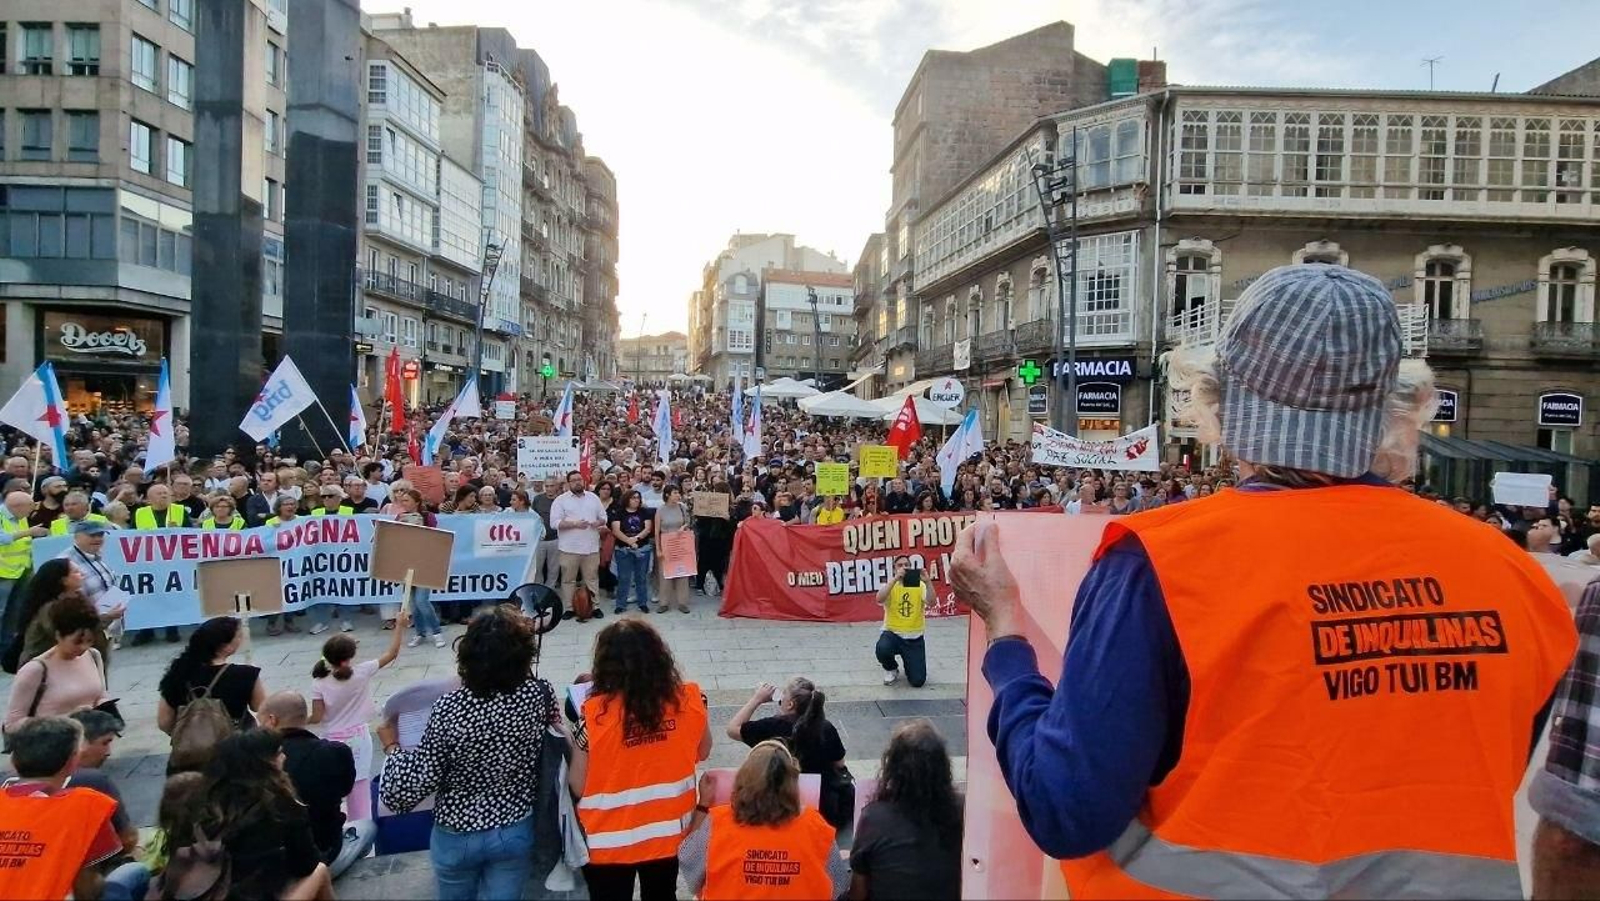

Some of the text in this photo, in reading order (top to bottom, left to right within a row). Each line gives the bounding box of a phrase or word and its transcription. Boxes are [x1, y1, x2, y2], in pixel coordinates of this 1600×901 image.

[1053, 361, 1132, 377] FARMACIA
[1078, 391, 1117, 400] FARMACIA
[1542, 402, 1579, 411] FARMACIA
[120, 532, 264, 563] VIVENDA
[277, 519, 360, 551] DIGNA
[489, 524, 521, 541] CIG
[843, 519, 901, 555] QUEN
[119, 573, 155, 596] AR
[164, 570, 183, 593] A
[282, 548, 369, 578] LACIÓN
[788, 572, 796, 586] O
[798, 571, 824, 587] MEU
[284, 573, 509, 604] GARANTIR EITOS
[1307, 576, 1445, 615] SINDICATO
[1318, 615, 1501, 658] DE INQUILINAS
[1323, 660, 1479, 701] VIGO TUI BM
[746, 850, 788, 860] SINDICATO
[744, 862, 756, 872] DE
[744, 875, 763, 885] VIGO
